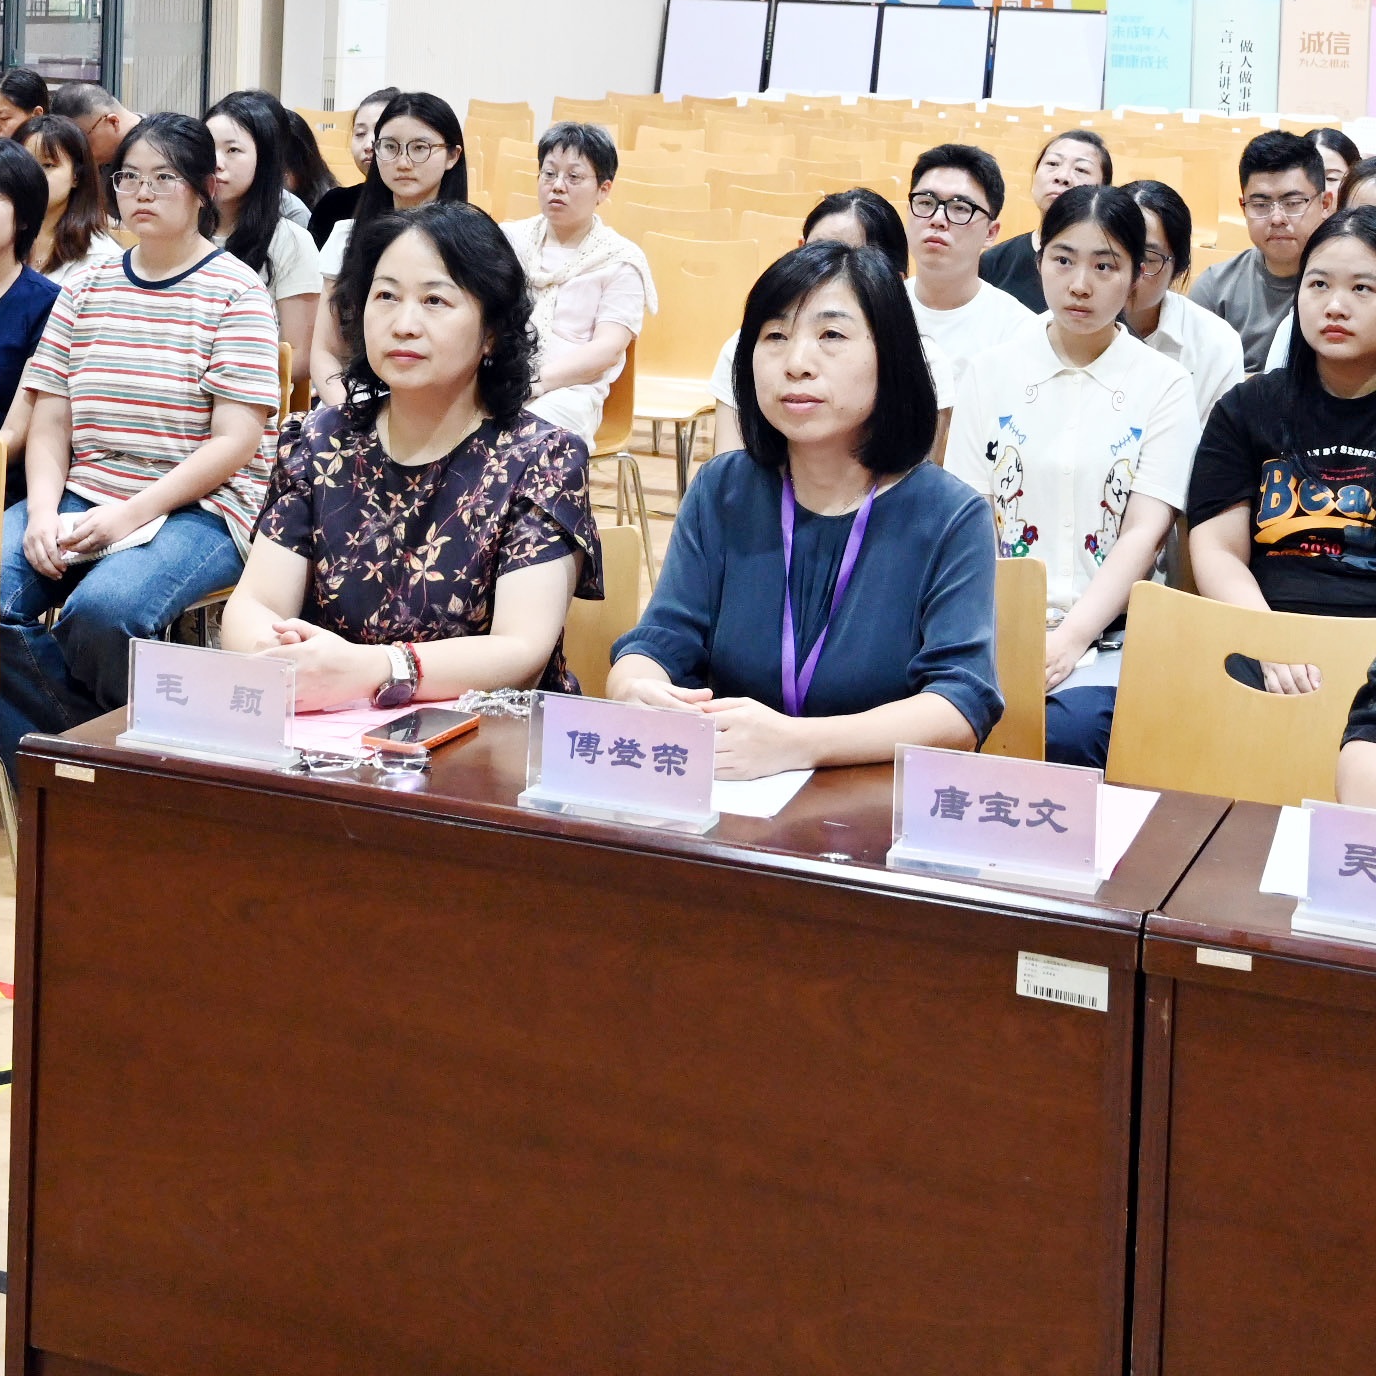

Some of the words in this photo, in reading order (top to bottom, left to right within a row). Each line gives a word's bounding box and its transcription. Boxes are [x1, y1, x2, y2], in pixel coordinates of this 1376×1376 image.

[1299, 31, 1351, 56] 诚信
[566, 730, 688, 776] 傅登荣
[930, 785, 1068, 834] 唐宝文
